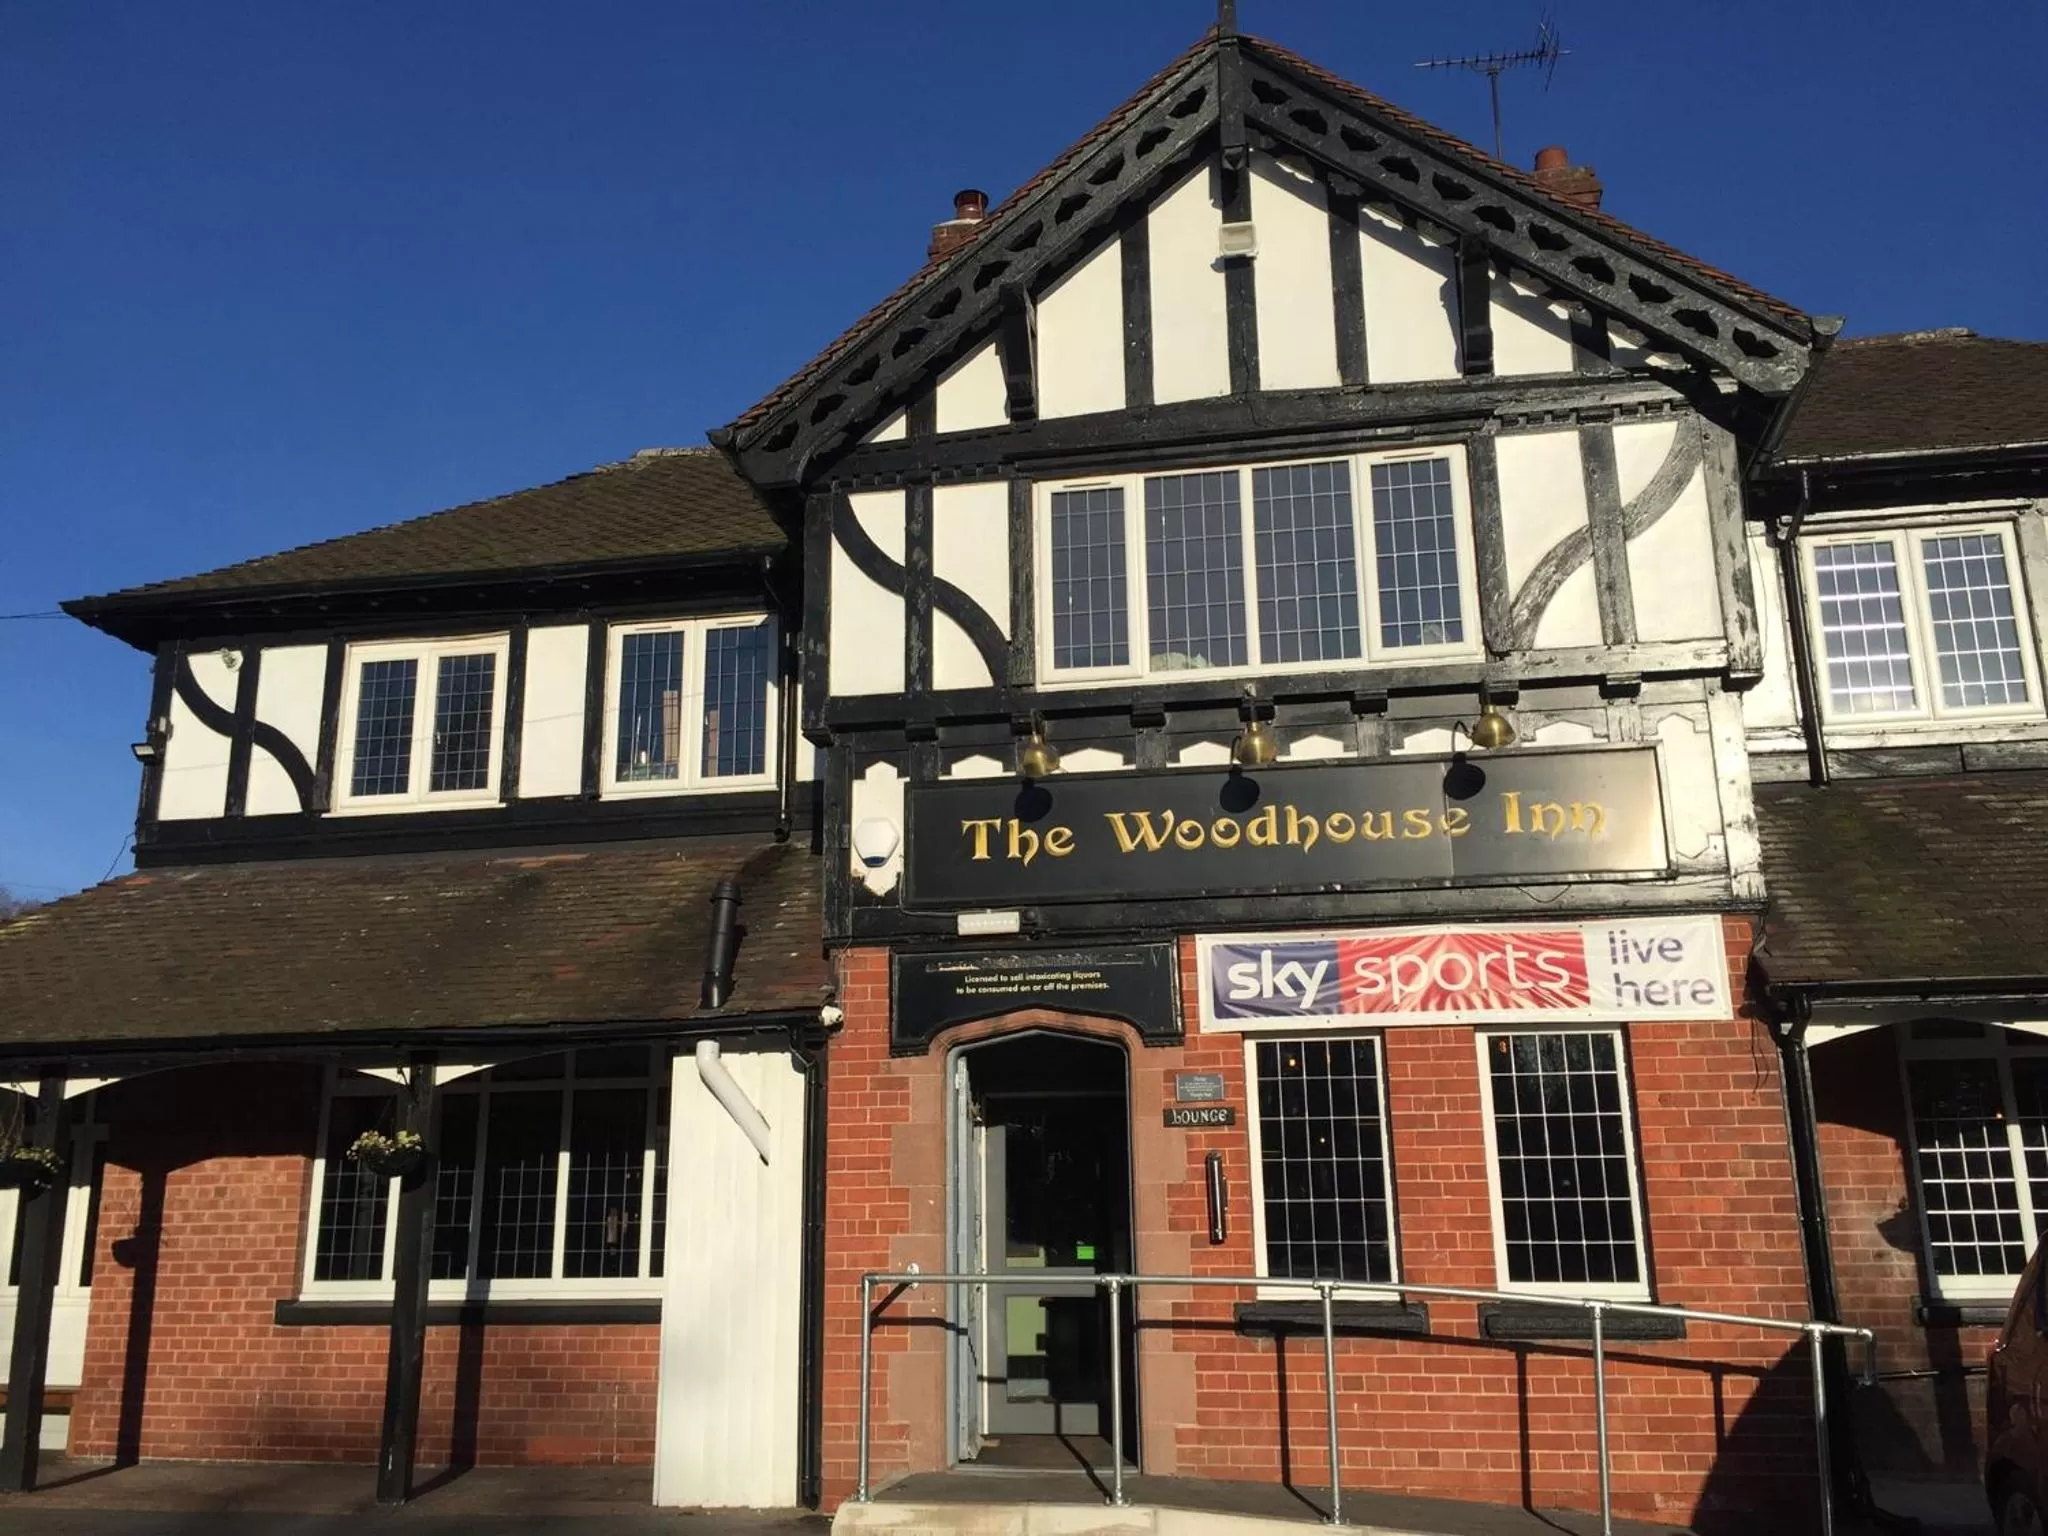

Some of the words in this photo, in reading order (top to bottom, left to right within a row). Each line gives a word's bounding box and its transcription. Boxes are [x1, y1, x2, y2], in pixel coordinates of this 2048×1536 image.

[961, 817, 1076, 867] The
[1104, 804, 1472, 854] Woodhouse
[1501, 791, 1608, 843] Inn
[1608, 929, 1684, 964] live
[965, 973, 999, 983] Licensed
[1000, 974, 1009, 982] to
[1010, 972, 1024, 981] sell
[1025, 971, 1071, 981] intoxicating
[1072, 970, 1100, 980] liquors
[966, 985, 977, 994] be
[978, 984, 1018, 993] consumed
[1043, 982, 1055, 991] off
[1056, 982, 1070, 990] the
[1227, 949, 1329, 1009] sky
[1354, 943, 1570, 1005] sports
[1614, 972, 1715, 1007] here
[1172, 1109, 1228, 1124] LOUNGE
